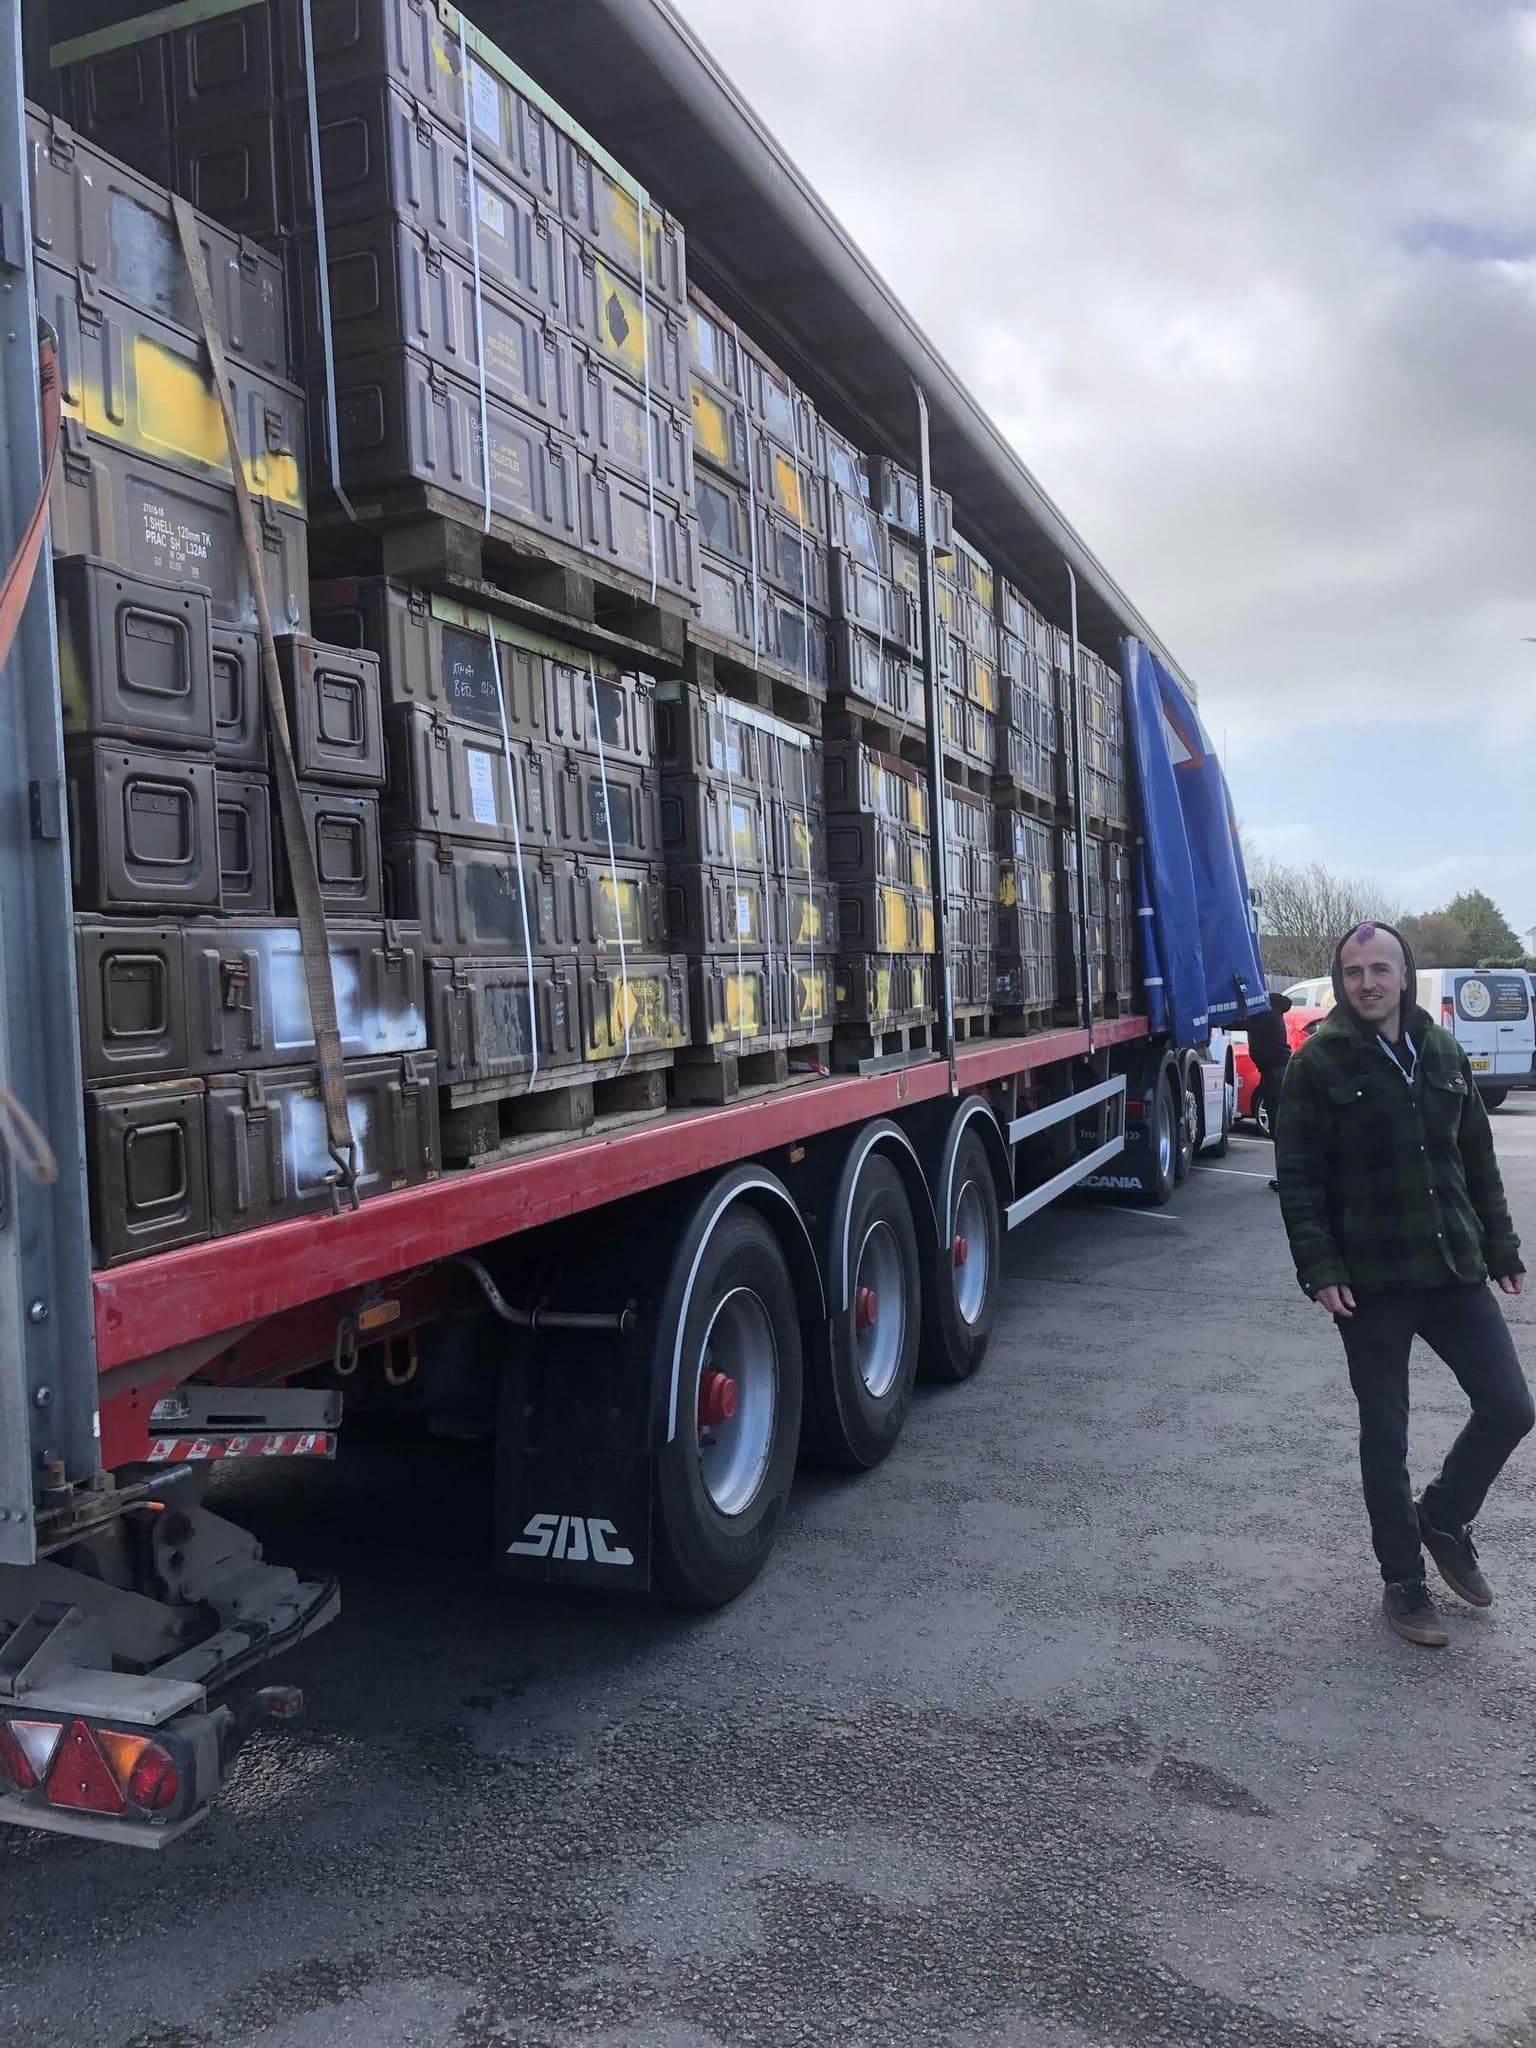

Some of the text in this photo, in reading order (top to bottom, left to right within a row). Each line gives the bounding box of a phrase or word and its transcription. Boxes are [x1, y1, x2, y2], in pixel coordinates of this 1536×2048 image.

[143, 515, 212, 547] 1 SHELL 120mm TK
[145, 529, 167, 548] PRAC
[170, 536, 181, 551] SH
[506, 1513, 634, 1566] SDC
